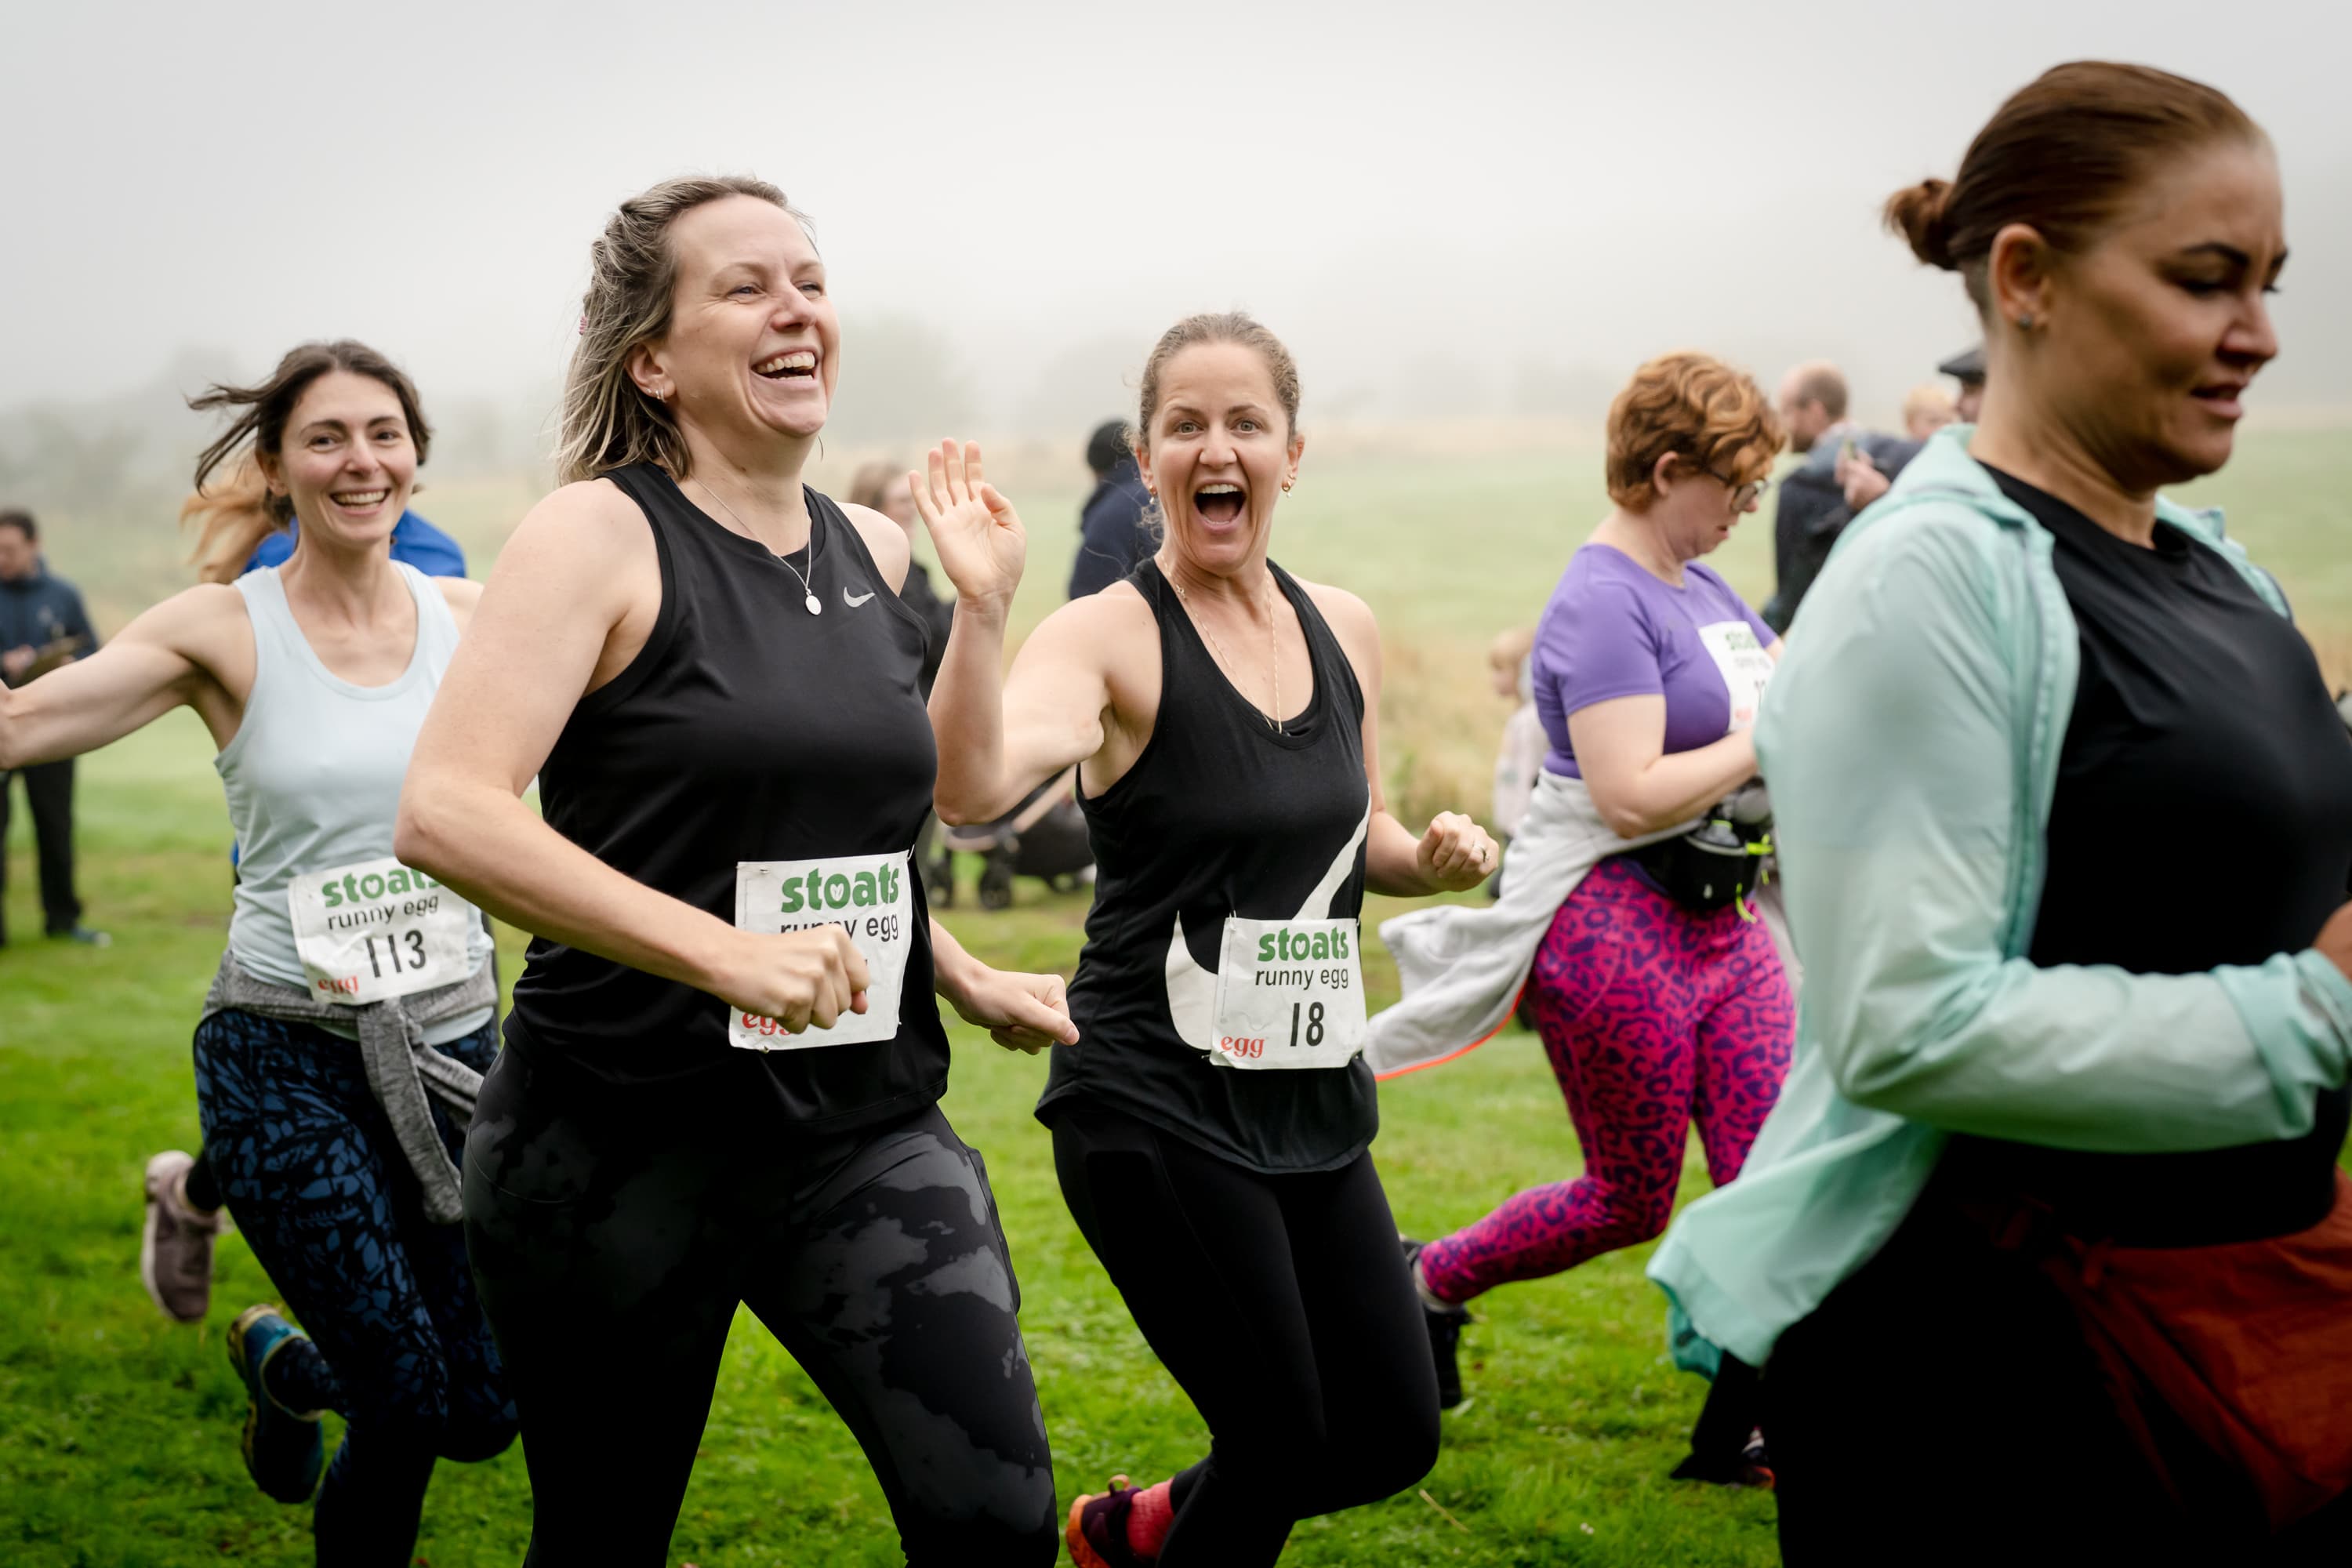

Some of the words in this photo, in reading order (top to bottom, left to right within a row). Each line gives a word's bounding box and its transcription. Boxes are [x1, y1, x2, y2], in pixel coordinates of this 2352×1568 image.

[321, 869, 440, 908] stoat
[781, 862, 899, 913] stoats
[328, 905, 395, 931] runny
[404, 895, 439, 916] egg
[866, 913, 898, 942] egg
[365, 930, 427, 978] 113
[1257, 926, 1348, 962] stoats
[1255, 969, 1314, 990] runny
[1320, 968, 1348, 989] egg
[1290, 1002, 1324, 1047] 18
[1221, 1036, 1265, 1058] egg
